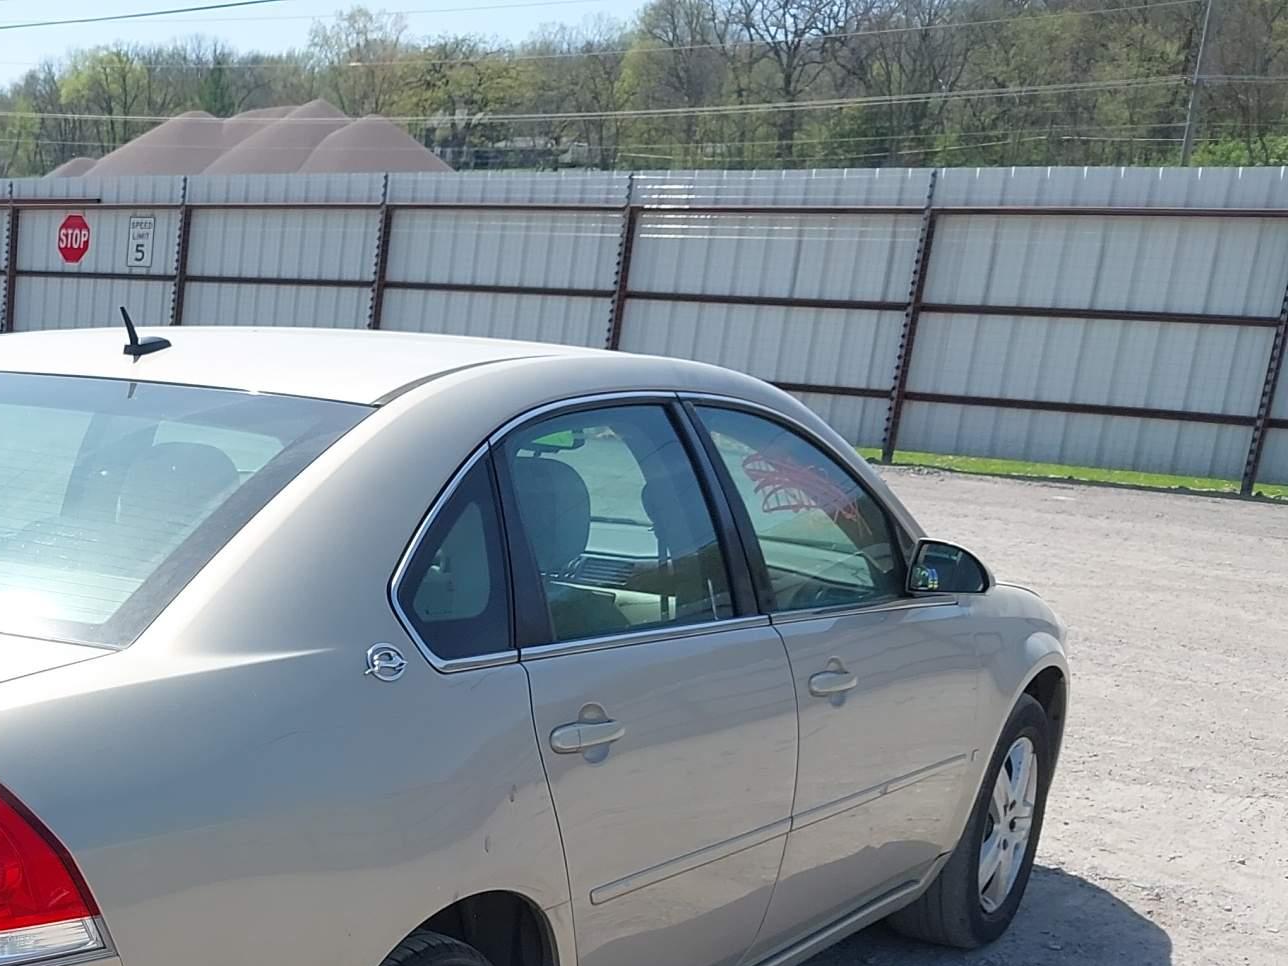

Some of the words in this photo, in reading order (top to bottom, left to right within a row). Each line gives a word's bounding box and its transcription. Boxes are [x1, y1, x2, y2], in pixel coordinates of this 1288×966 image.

[131, 221, 153, 230] SPEED
[59, 228, 89, 249] STOP
[132, 231, 151, 241] LIMIT
[134, 243, 145, 262] 5
